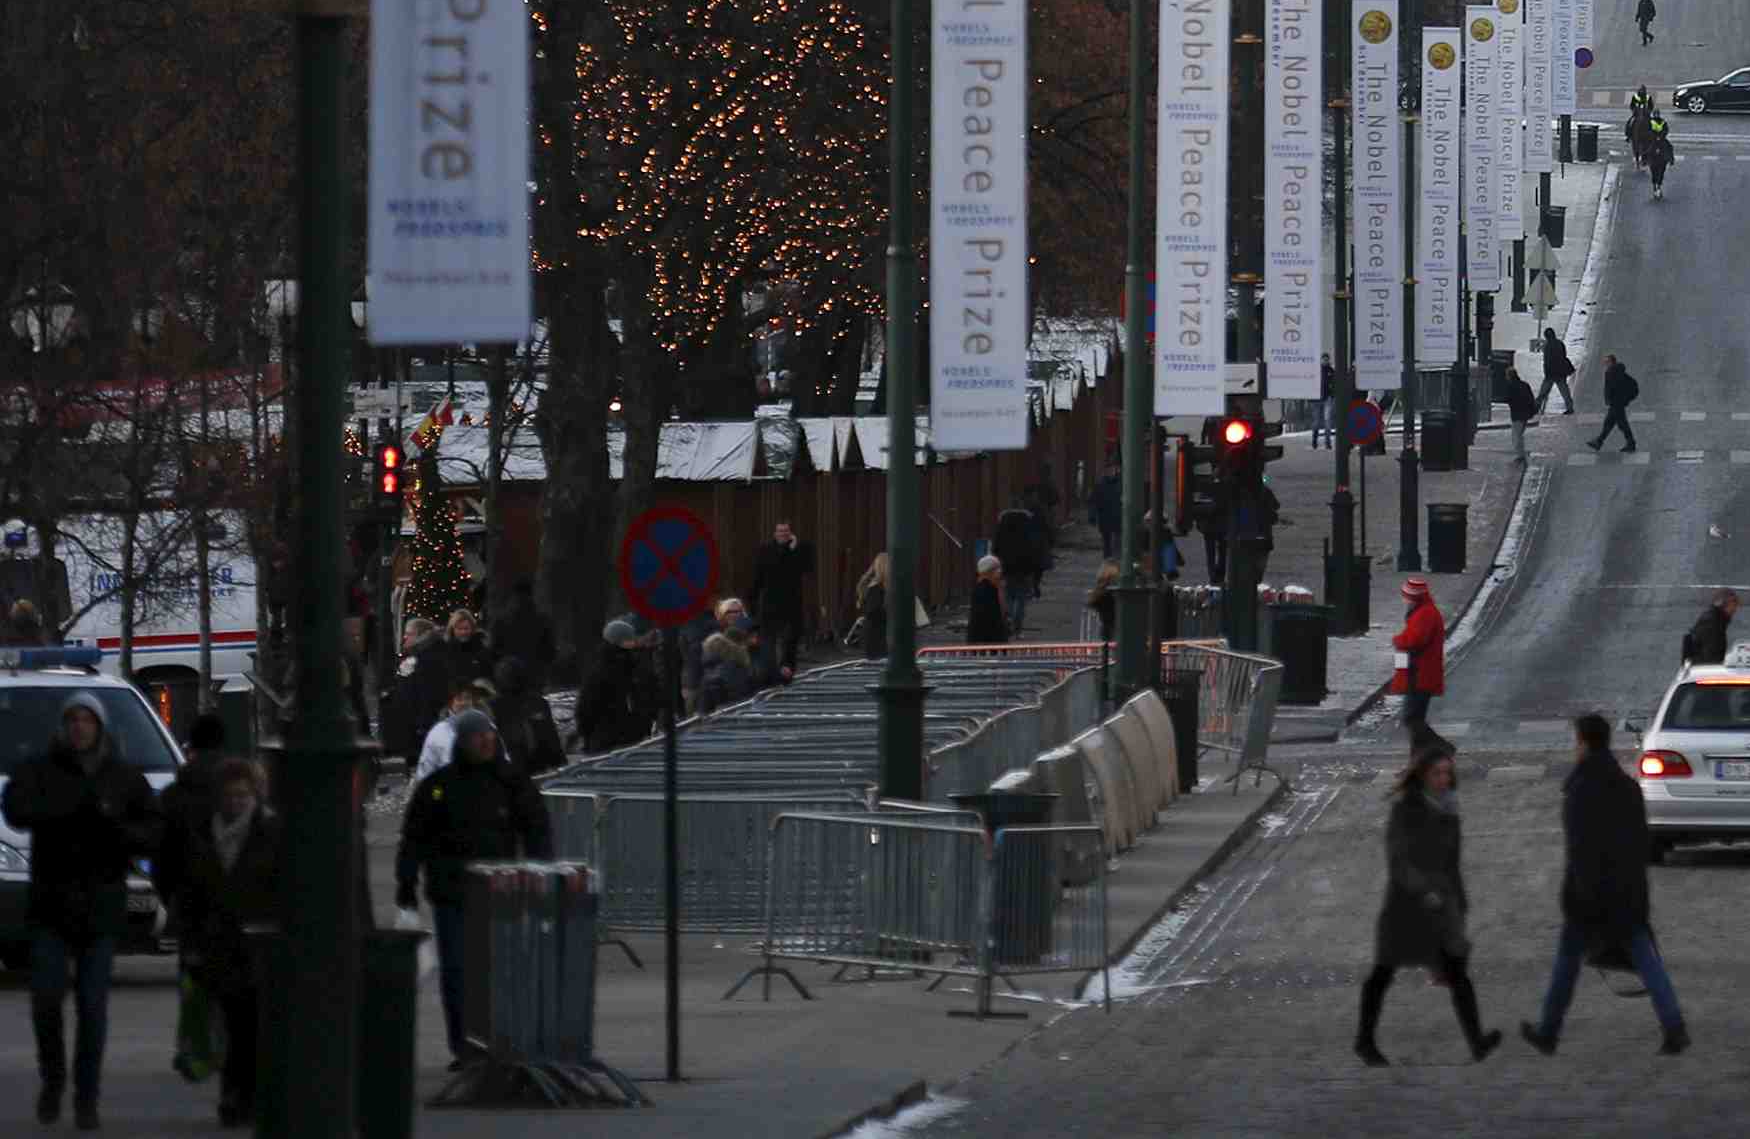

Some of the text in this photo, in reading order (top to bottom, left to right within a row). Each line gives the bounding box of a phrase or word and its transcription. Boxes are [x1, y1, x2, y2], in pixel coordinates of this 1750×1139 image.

[1533, 16, 1546, 54] Nobel
[962, 58, 1005, 193] Peace
[1282, 56, 1309, 138] Nobel
[1501, 28, 1518, 212] The Nobel Peace Prize
[1533, 65, 1545, 104] Peace
[1534, 115, 1546, 148] Prize
[1181, 127, 1212, 228] Peace
[1367, 63, 1391, 345] The Nobel Peace Prize
[1475, 56, 1493, 260] The Nobel Peace Prize
[1282, 164, 1308, 247] Peace
[1431, 87, 1452, 325] The Nobel Peace Prize
[963, 238, 1006, 357] Prize
[1180, 260, 1211, 347] Prize
[1282, 271, 1309, 342] Prize
